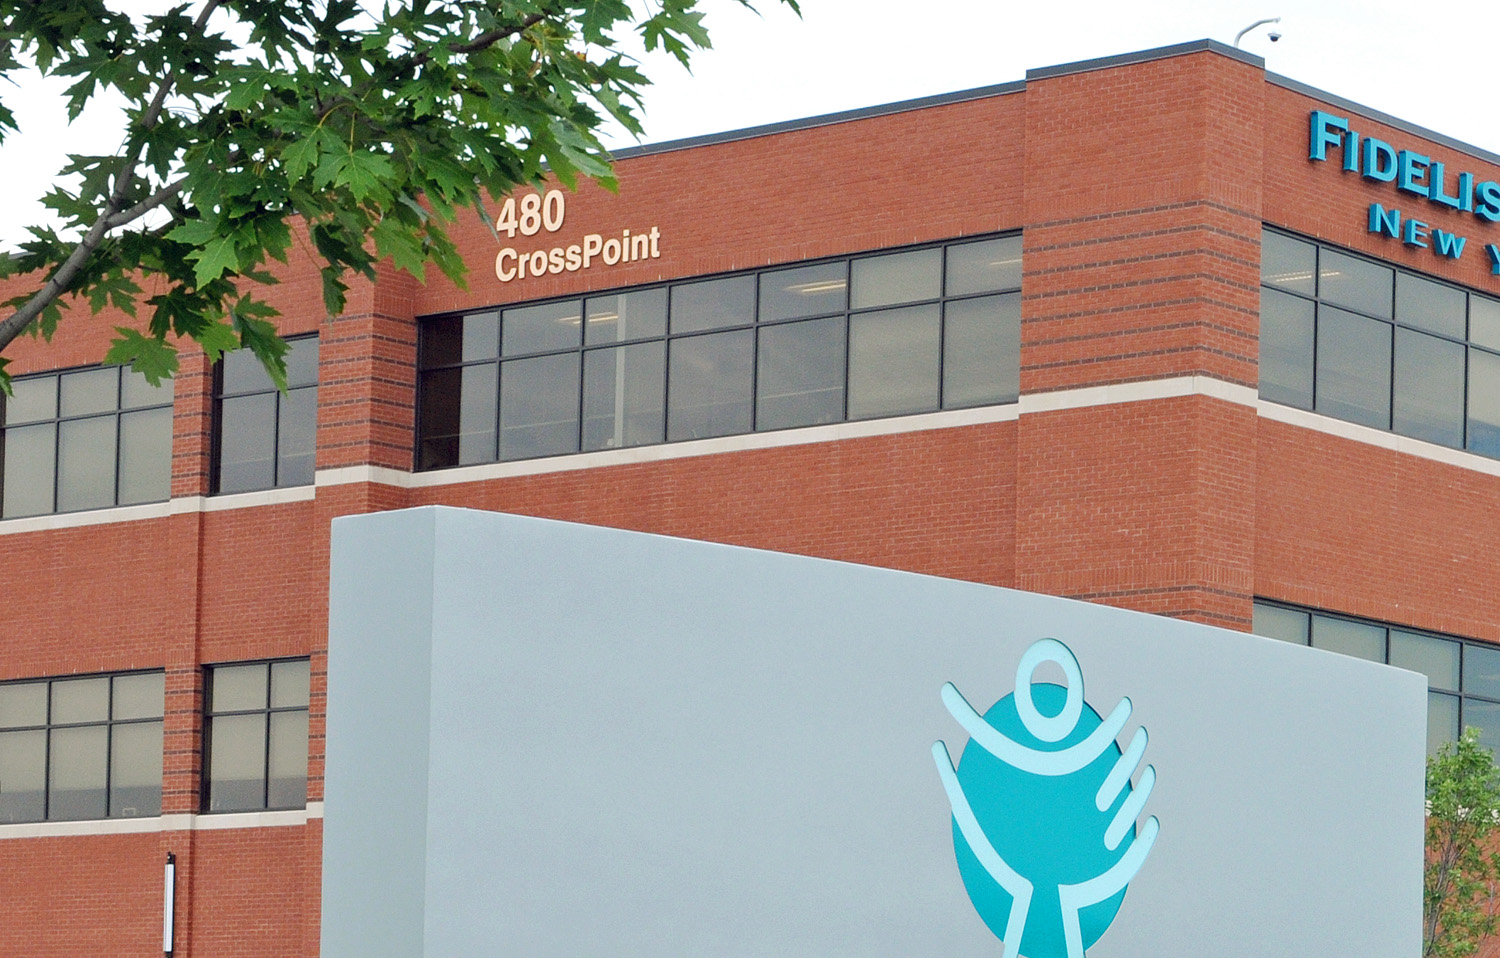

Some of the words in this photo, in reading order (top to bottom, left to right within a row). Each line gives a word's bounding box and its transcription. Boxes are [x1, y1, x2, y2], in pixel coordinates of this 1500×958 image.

[497, 189, 565, 238] 480
[1368, 203, 1466, 259] NEW
[495, 226, 661, 282] CrossPoint
